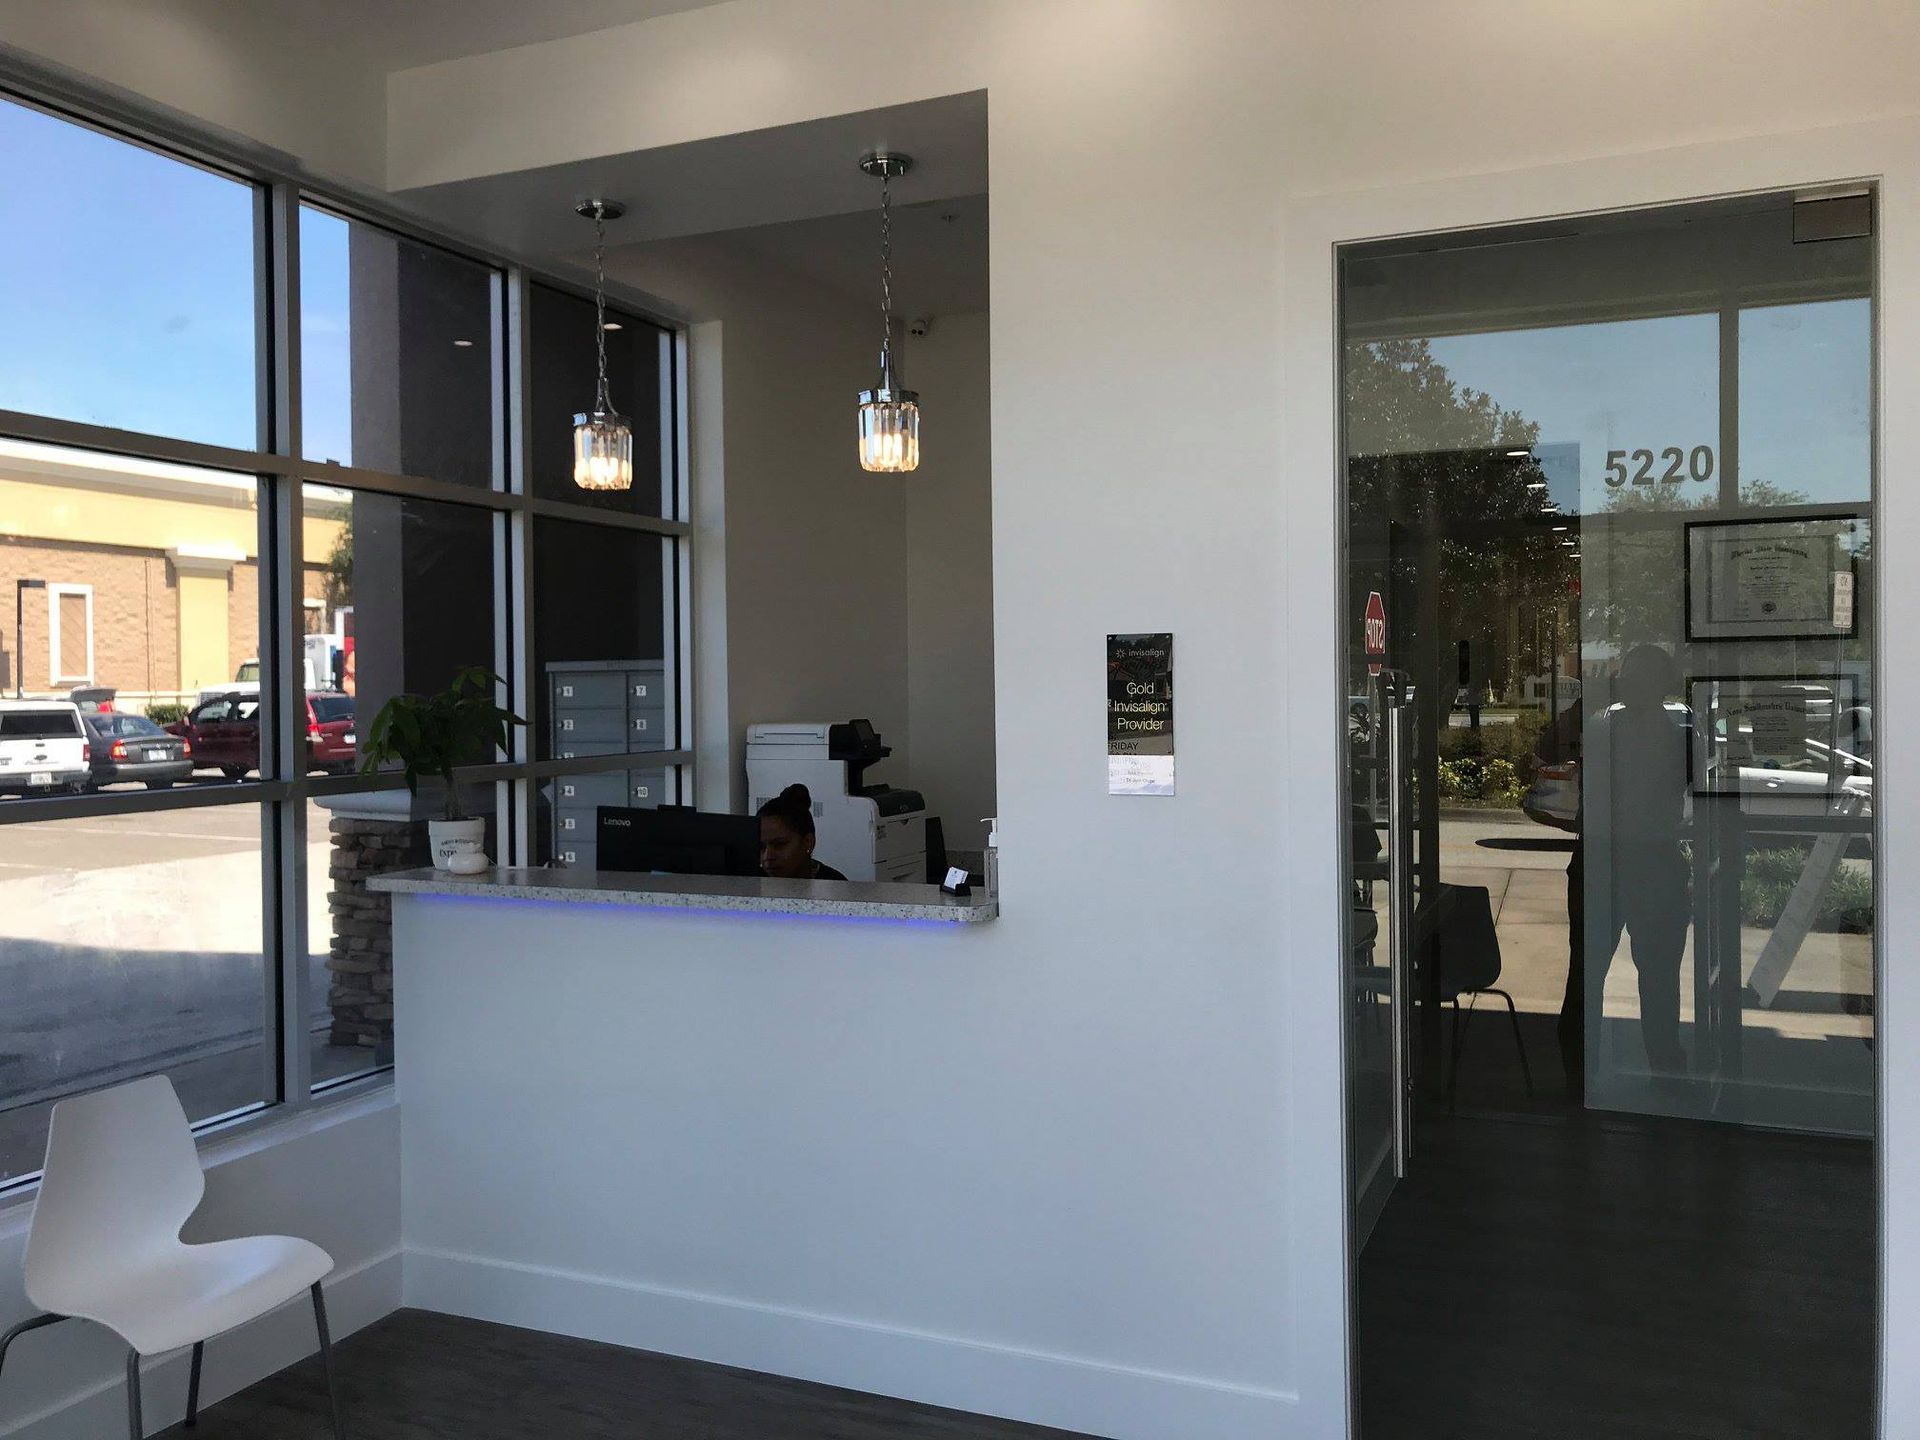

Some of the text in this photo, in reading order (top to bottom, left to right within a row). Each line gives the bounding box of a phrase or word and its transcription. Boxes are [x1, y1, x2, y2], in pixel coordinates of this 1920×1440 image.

[1605, 445, 1713, 487] 5220
[1128, 648, 1164, 658] invisalign
[1126, 682, 1154, 695] Gold
[1114, 700, 1165, 715] Invisalign
[1117, 718, 1165, 730] Provider
[604, 817, 631, 826] Lenovo
